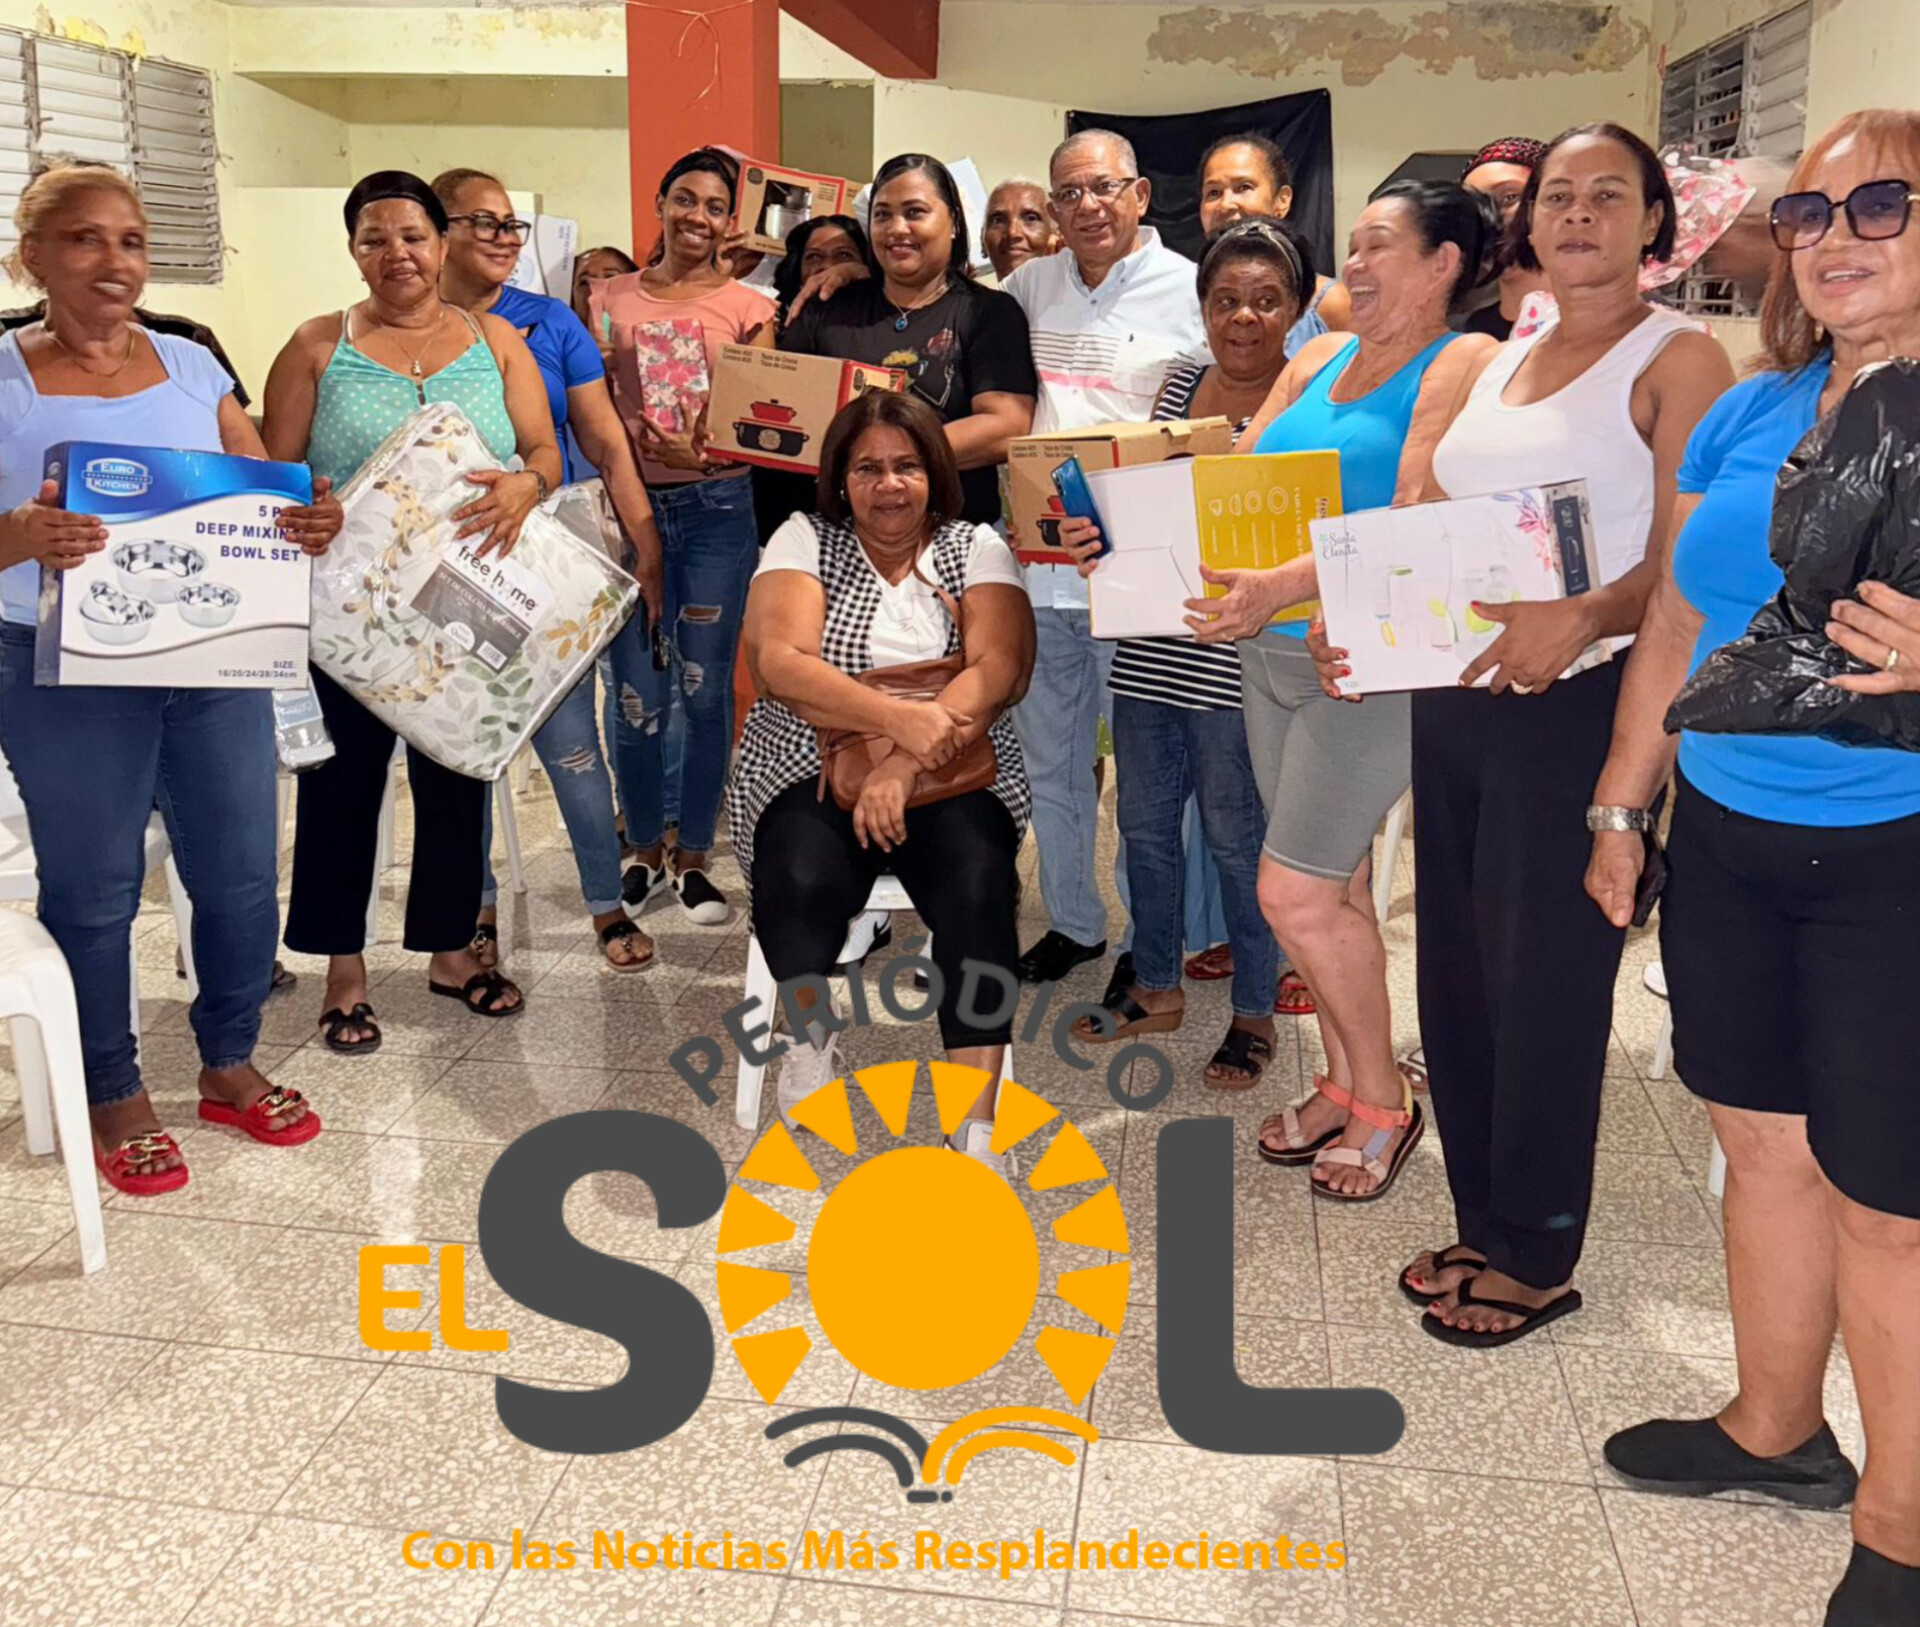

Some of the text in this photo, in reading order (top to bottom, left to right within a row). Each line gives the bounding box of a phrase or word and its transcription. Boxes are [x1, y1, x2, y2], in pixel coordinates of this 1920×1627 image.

[100, 463, 136, 475] EURO
[93, 479, 140, 490] KITCHEN
[259, 505, 267, 517] 5
[195, 521, 297, 540] DEEP MIXIN
[1329, 531, 1357, 546] Santa
[220, 545, 301, 562] BOWL SET
[458, 545, 537, 611] free home
